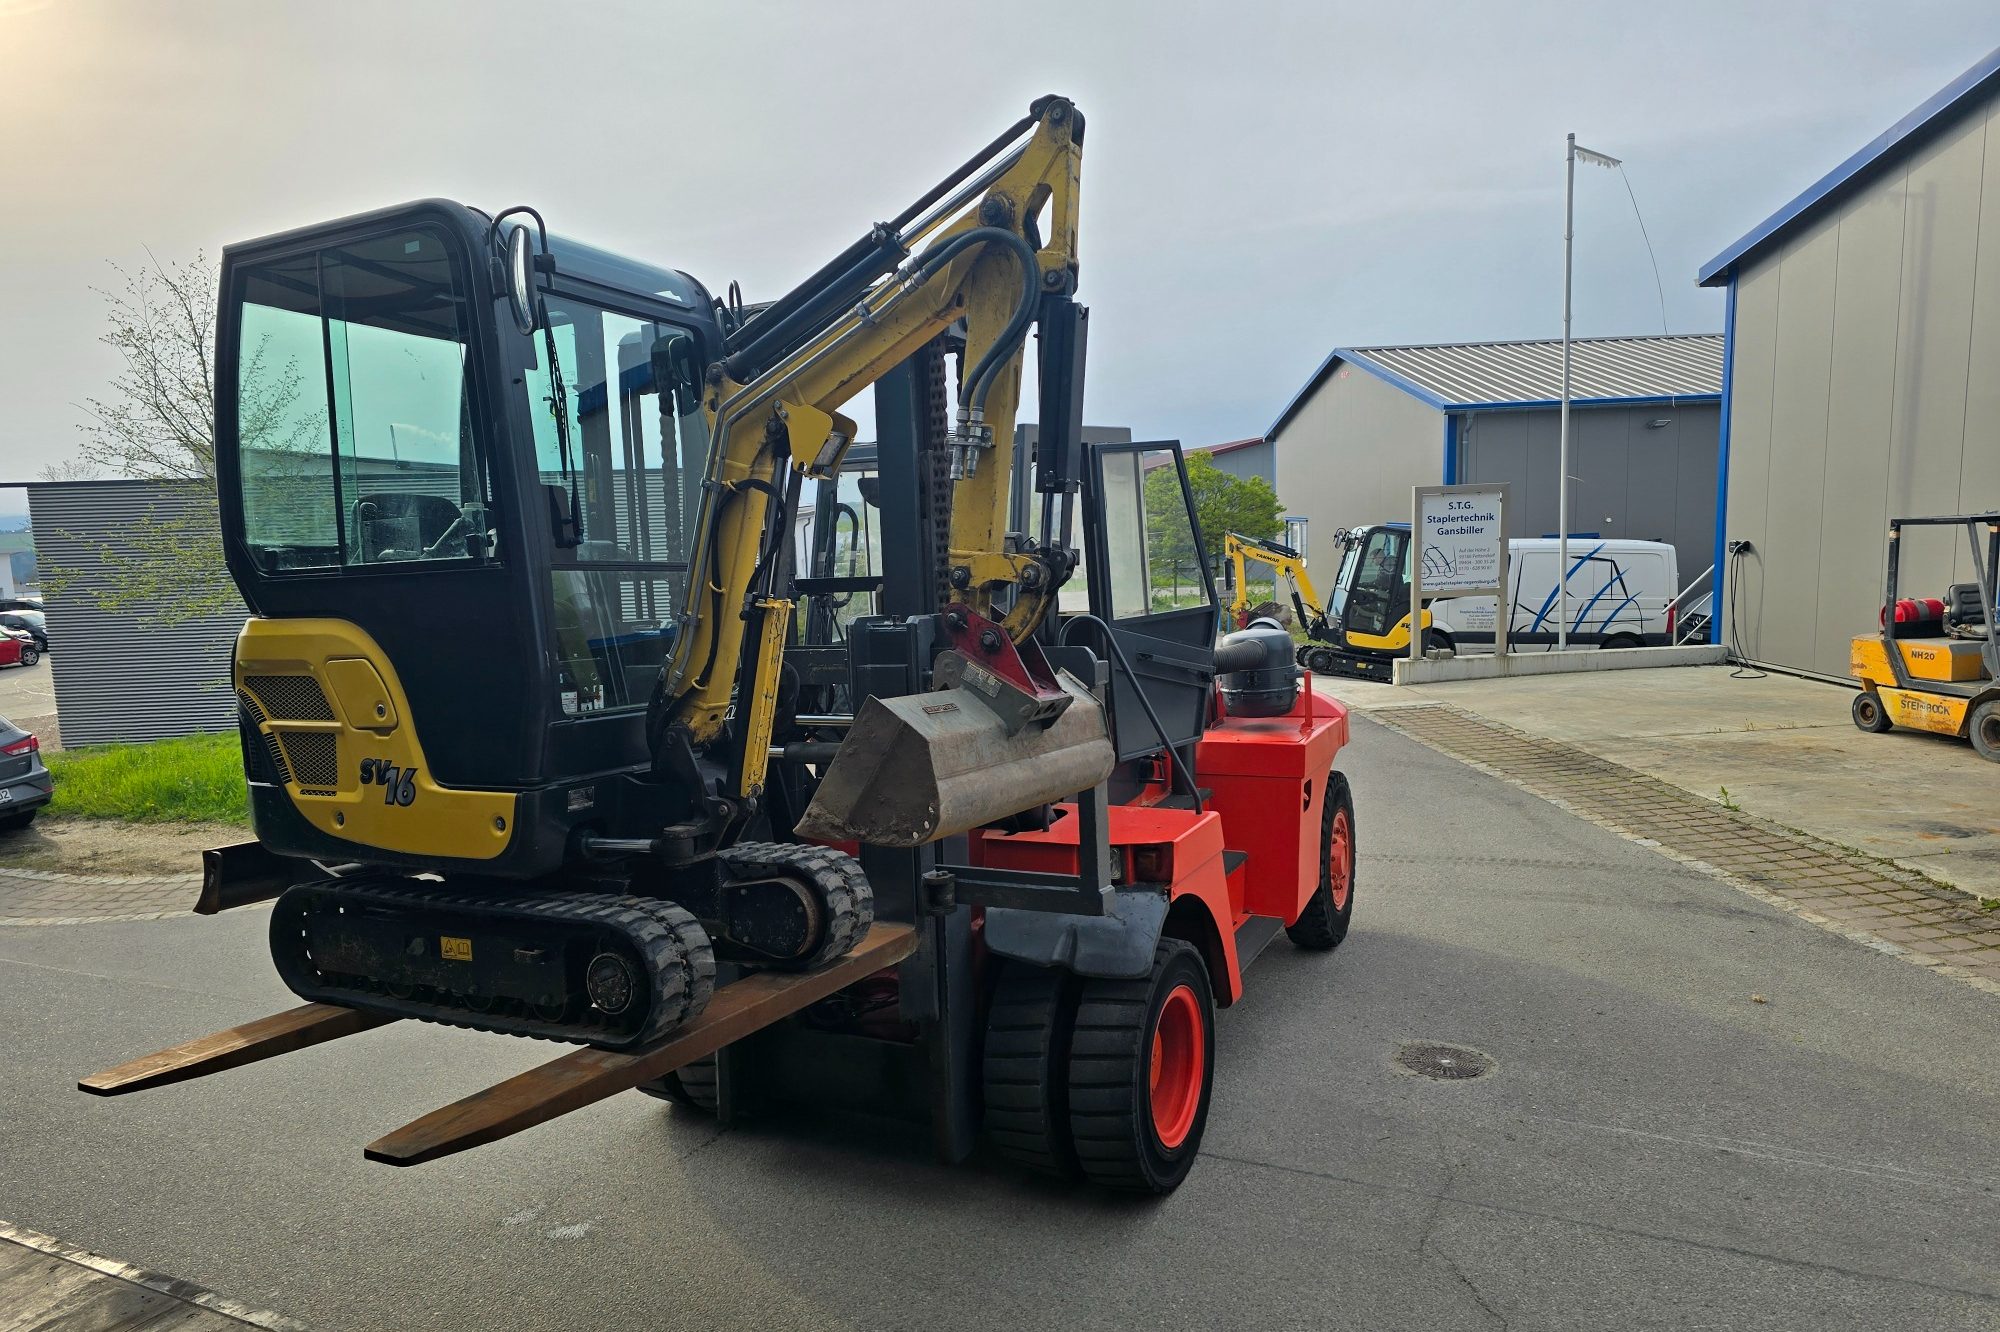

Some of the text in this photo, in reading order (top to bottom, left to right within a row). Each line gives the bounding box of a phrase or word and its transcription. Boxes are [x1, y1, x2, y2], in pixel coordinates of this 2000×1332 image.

[1448, 501, 1474, 510] S.T.G.
[1427, 513, 1495, 525] Staplertechnik
[1437, 526, 1484, 535] Gansbiller
[1256, 553, 1280, 563] YANMAR
[1911, 650, 1936, 661] NH20
